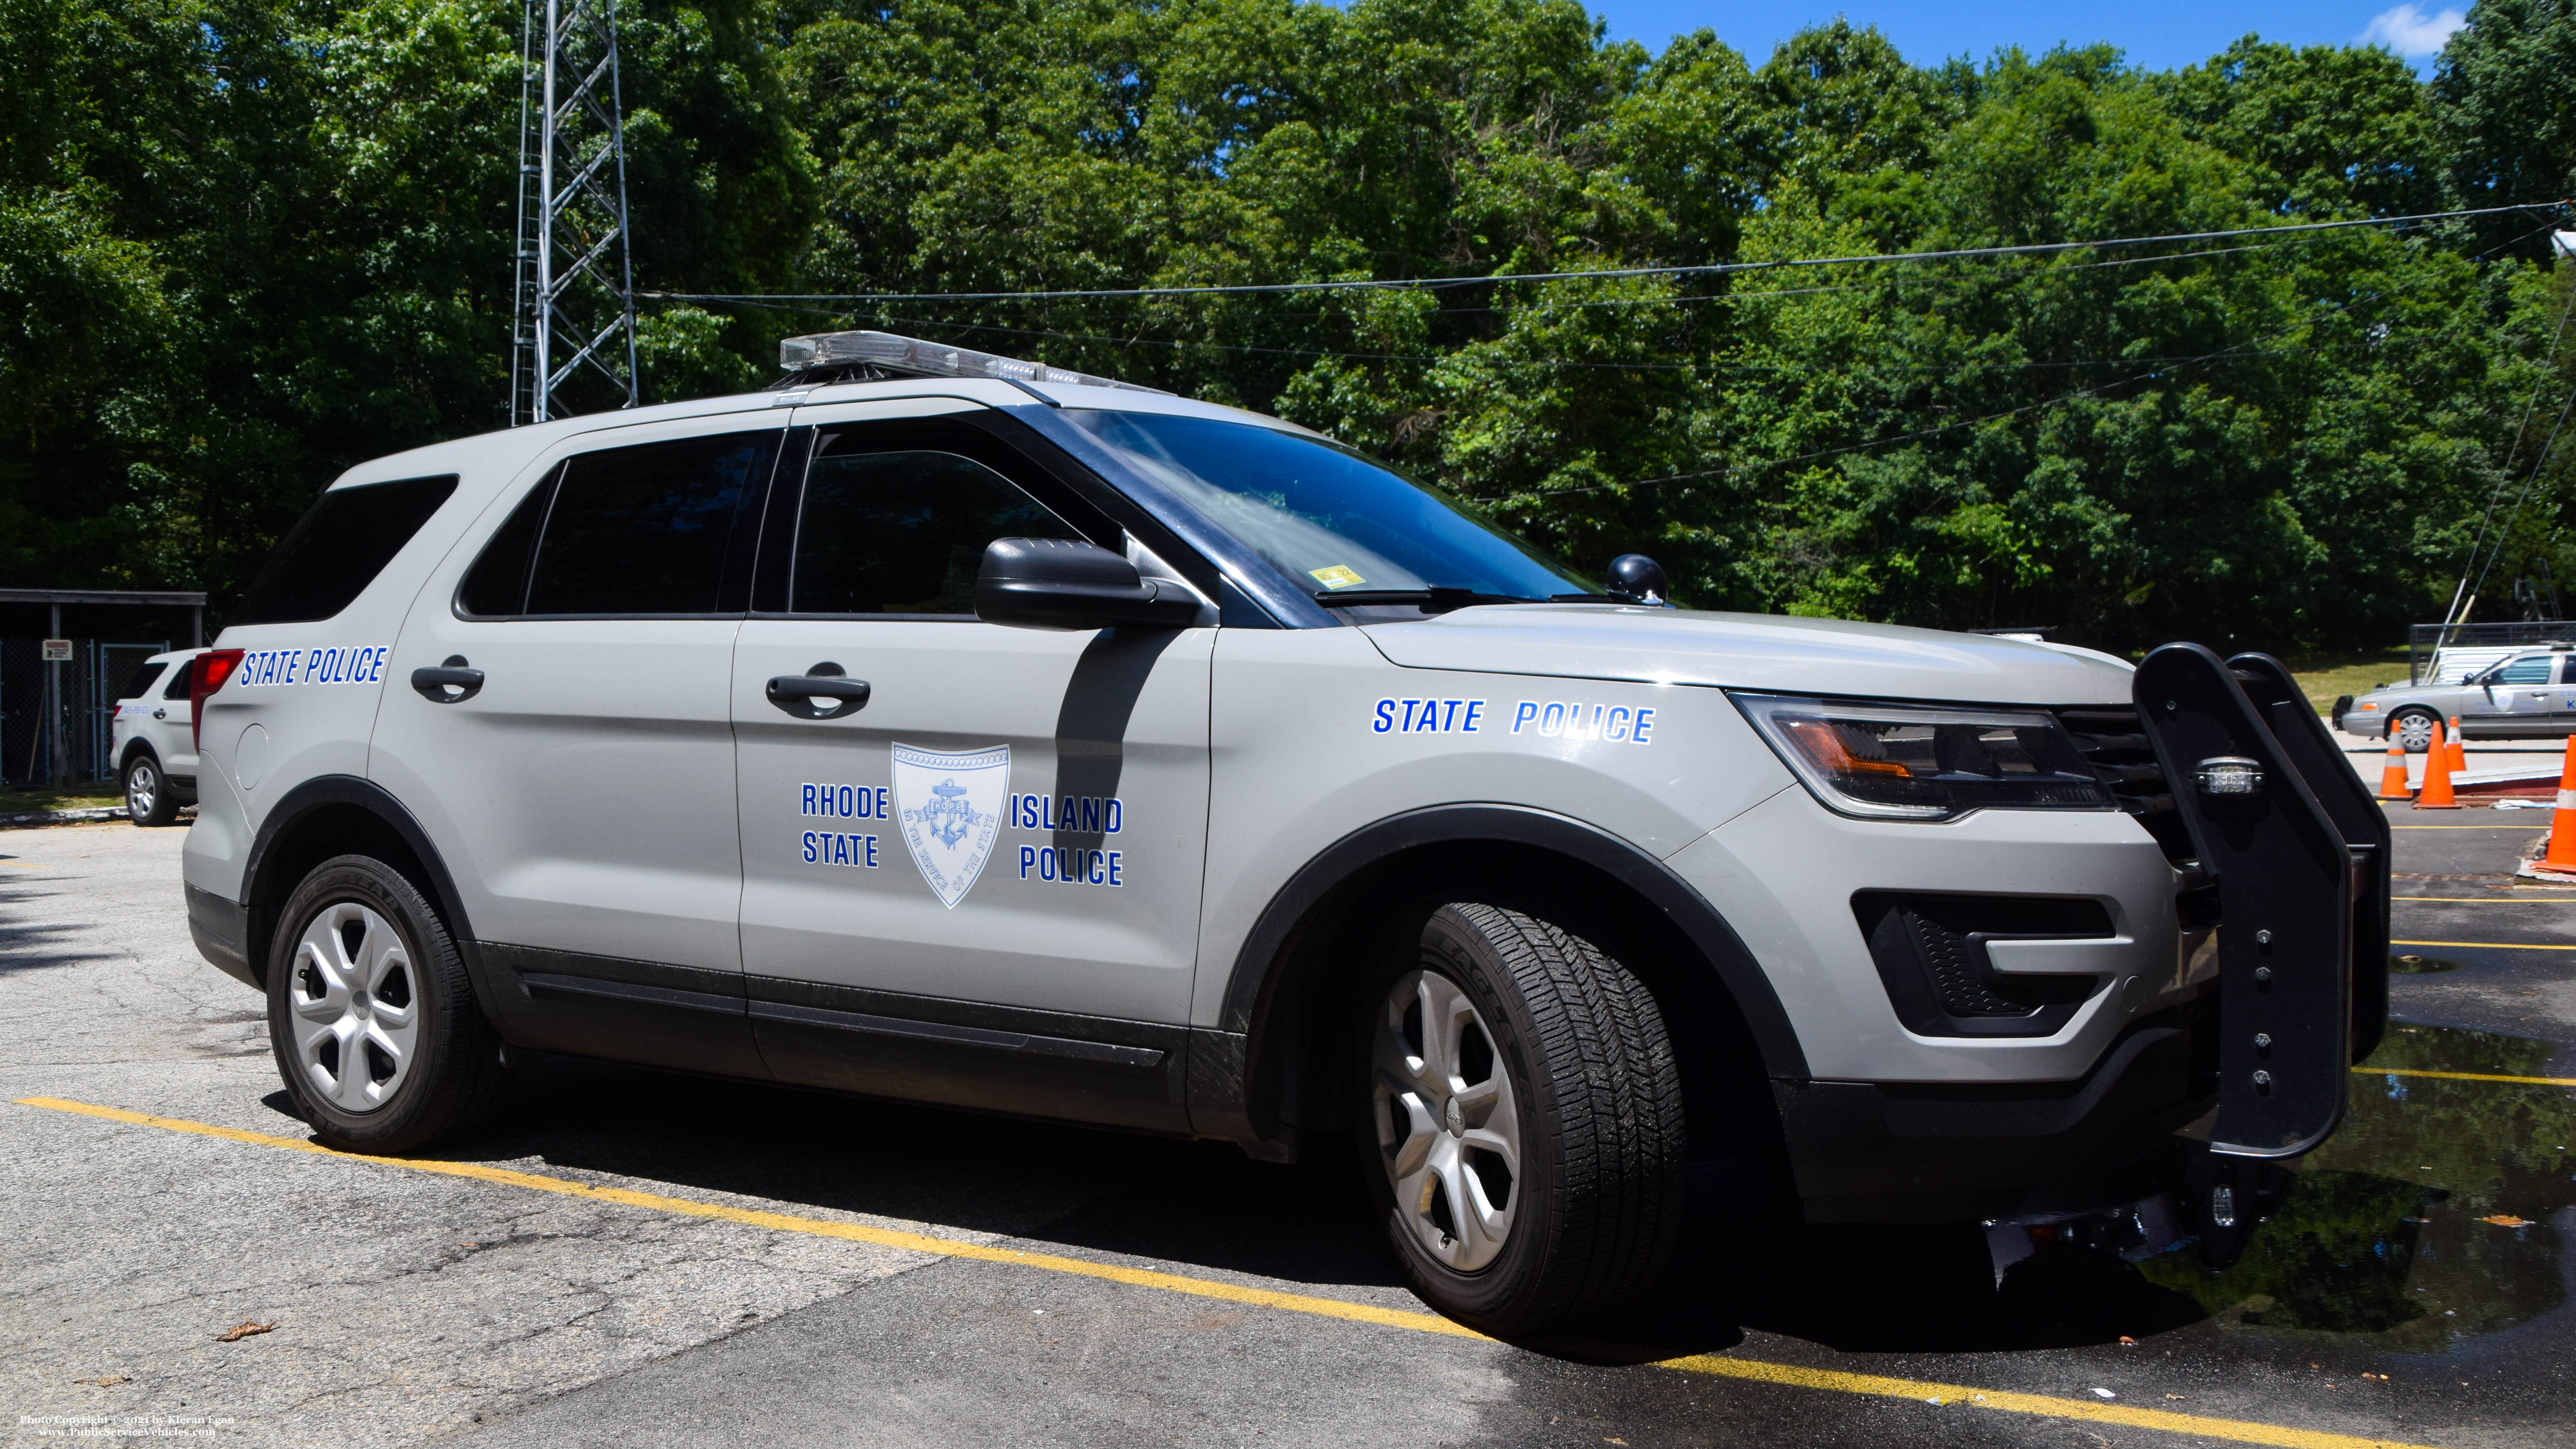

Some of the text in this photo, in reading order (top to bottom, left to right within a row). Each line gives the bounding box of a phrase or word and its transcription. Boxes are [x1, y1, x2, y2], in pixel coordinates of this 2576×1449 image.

[240, 645, 389, 688] STATE POLICE
[1371, 697, 1656, 745] STATE POLICE
[801, 783, 1123, 834] RHODE ISLAND
[935, 802, 962, 811] HOPE
[802, 831, 1123, 887] STATE POLICE
[904, 808, 995, 891] IN THE SERVICE OF THE STATE
[295, 873, 398, 910] GOODYEAR
[1441, 937, 1518, 1047] EAGLE
